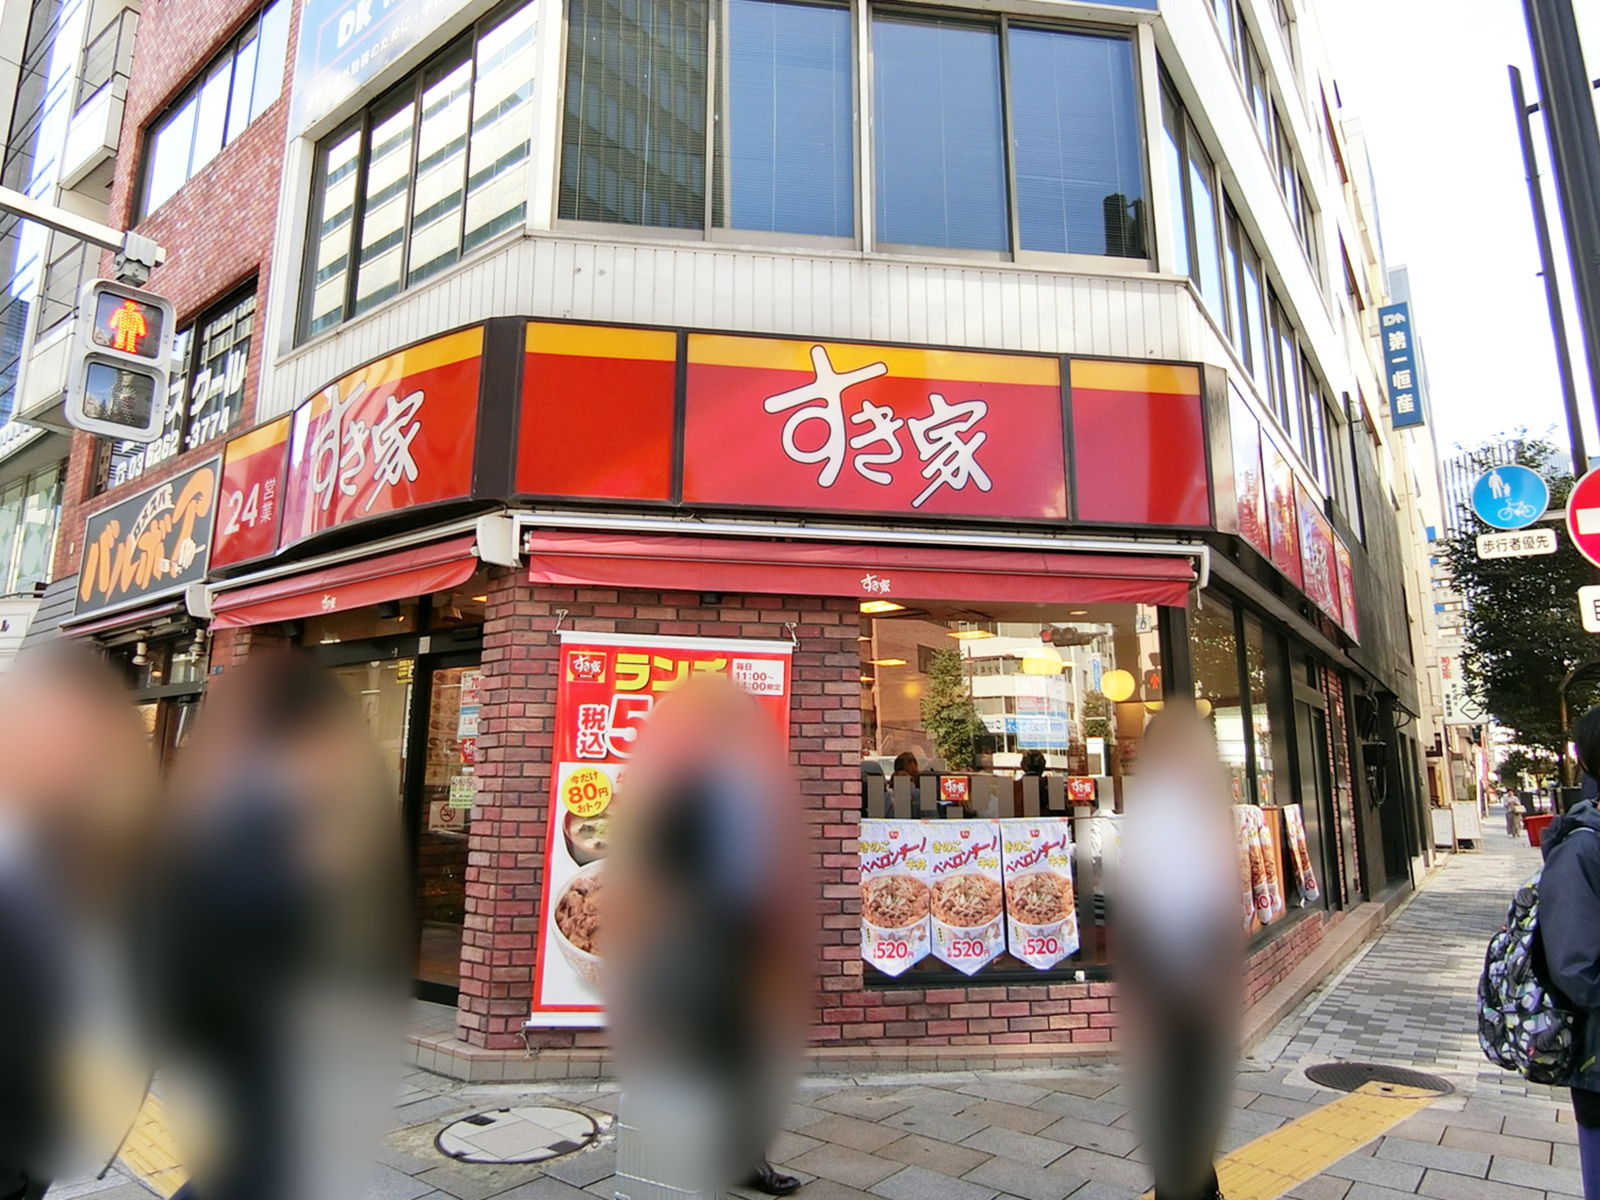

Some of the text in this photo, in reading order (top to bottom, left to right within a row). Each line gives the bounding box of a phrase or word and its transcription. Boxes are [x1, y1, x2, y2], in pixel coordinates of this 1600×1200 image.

[1389, 331, 1415, 414] 第一恒産
[165, 350, 247, 425] スクール
[763, 344, 993, 509] すき家
[310, 380, 425, 512] すき家
[224, 483, 260, 535] 24
[1482, 535, 1549, 554] 歩行者優先
[861, 573, 890, 594] すき家
[573, 654, 601, 675] すき家
[579, 705, 607, 757] 税込
[605, 695, 654, 759] 5
[570, 771, 598, 784] 今だけ
[944, 778, 966, 793] すき家
[1071, 779, 1092, 793] すき家
[568, 782, 609, 804] 80円
[577, 800, 602, 813] おトク
[860, 841, 890, 853] きのこ
[932, 840, 962, 853] きのこ
[1004, 840, 1032, 853] きのこ
